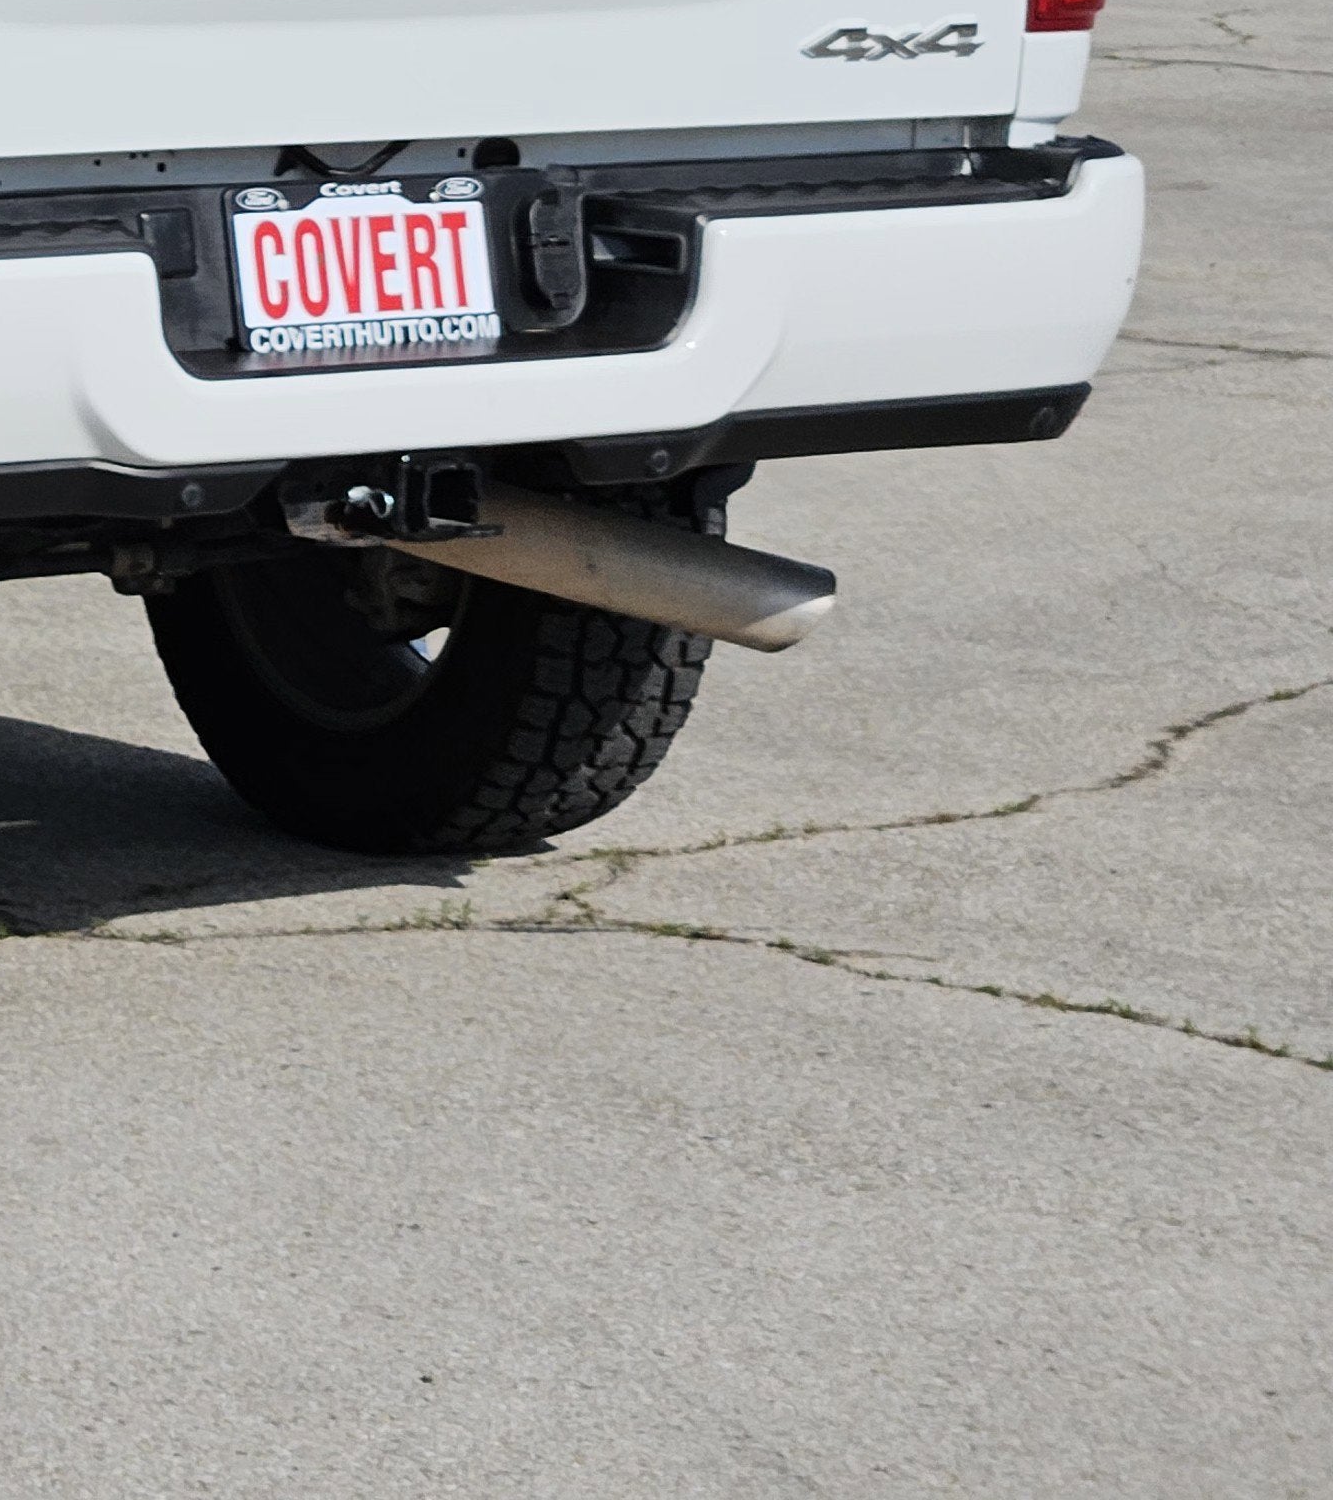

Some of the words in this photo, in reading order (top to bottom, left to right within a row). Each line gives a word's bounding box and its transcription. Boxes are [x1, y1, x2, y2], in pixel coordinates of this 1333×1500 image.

[800, 22, 985, 61] 4x4
[320, 181, 402, 197] Covert
[252, 211, 469, 320] COVERT
[249, 313, 501, 354] COVERTHUTTO.COM
